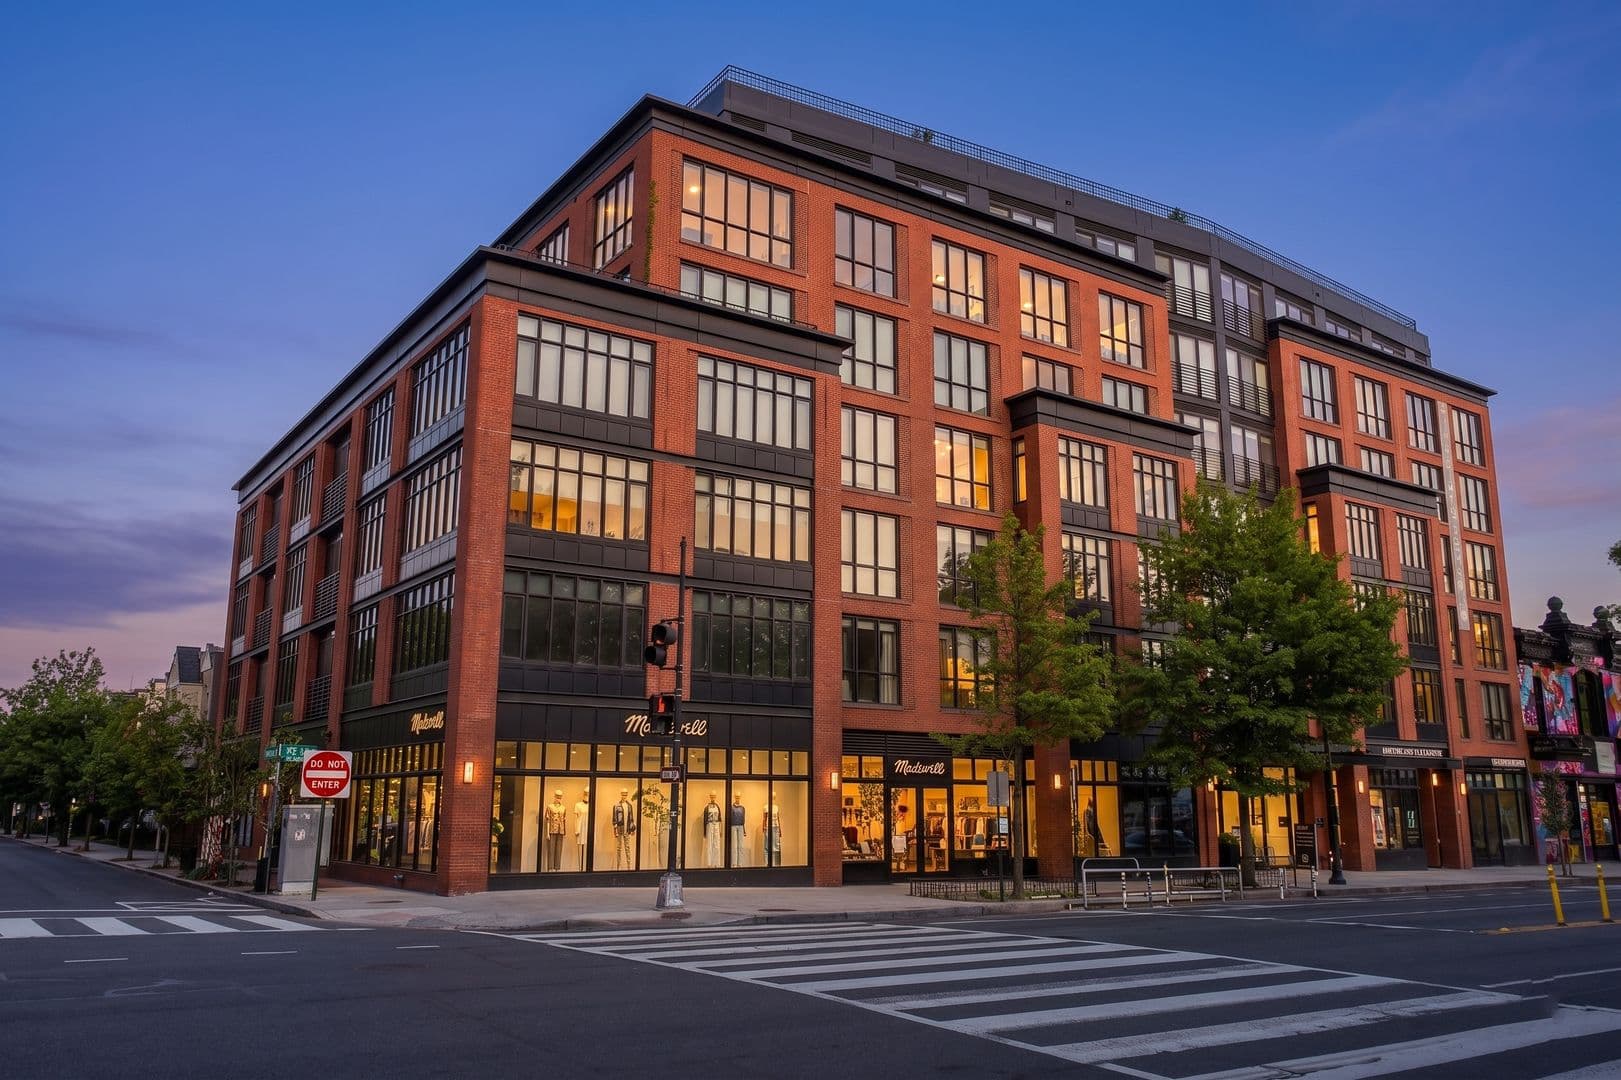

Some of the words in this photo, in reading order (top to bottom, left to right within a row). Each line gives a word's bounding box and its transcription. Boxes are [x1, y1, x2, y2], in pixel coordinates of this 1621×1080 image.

[625, 714, 707, 736] Maell
[310, 759, 323, 768] DO
[328, 760, 345, 769] NOT
[894, 759, 945, 776] Madewell
[311, 780, 340, 789] ENTER
